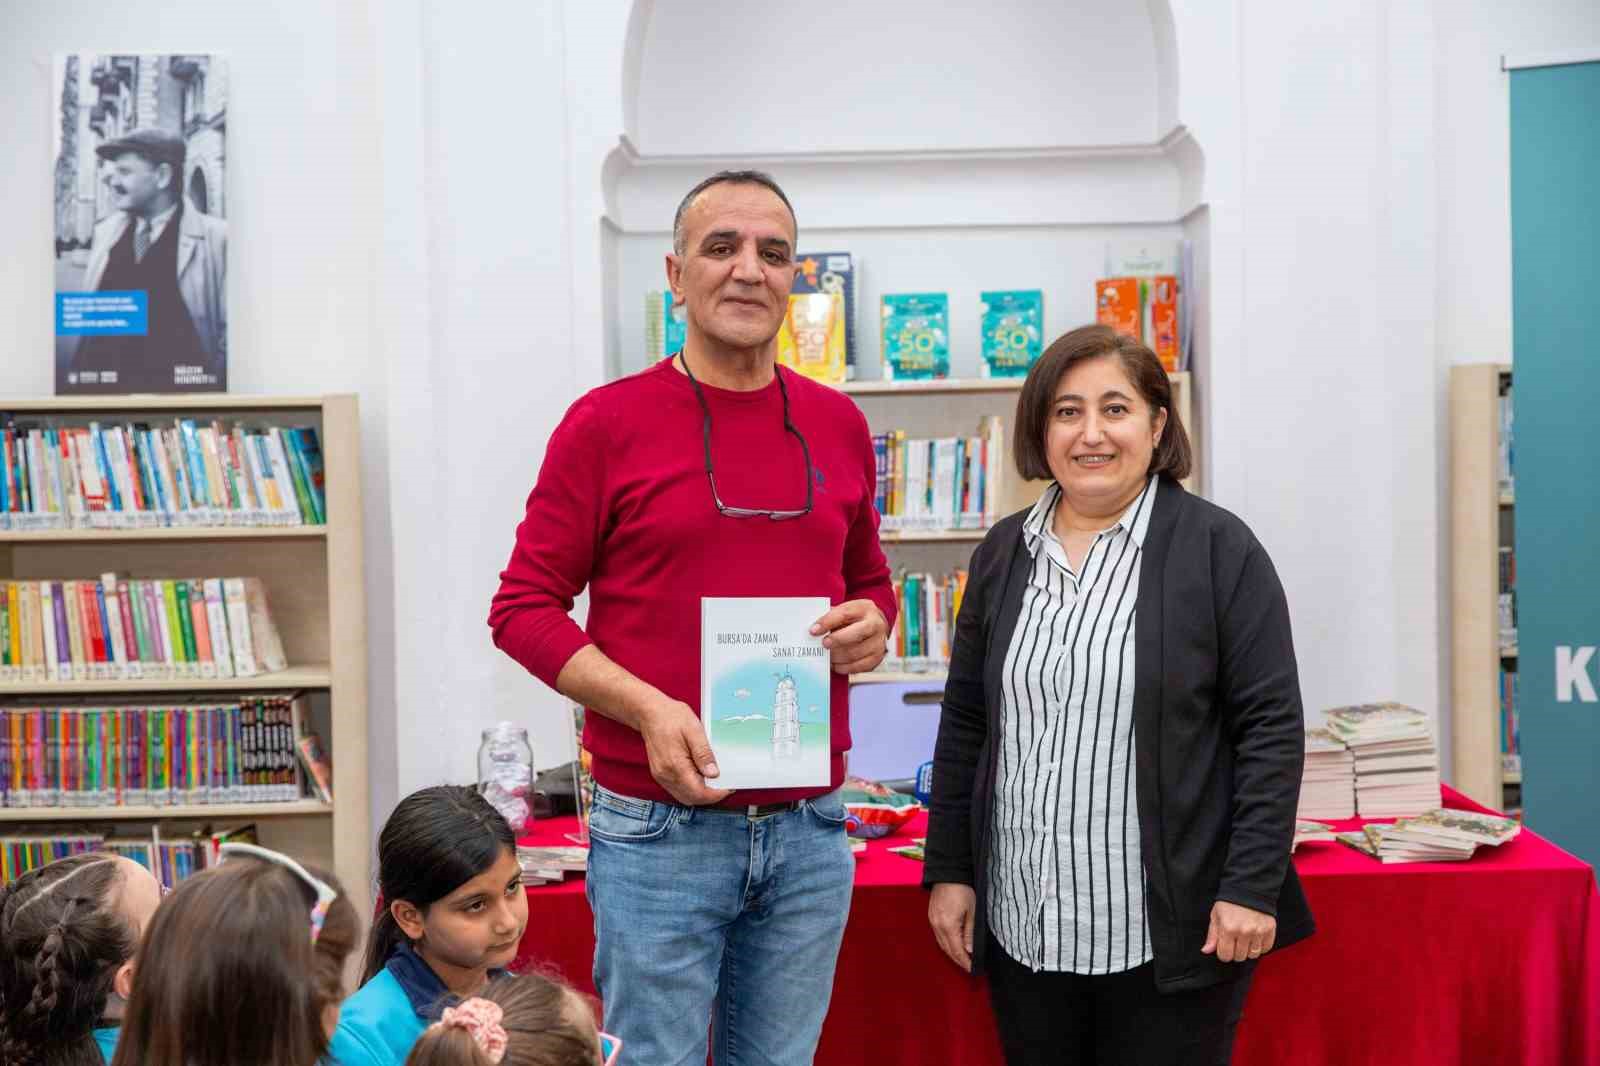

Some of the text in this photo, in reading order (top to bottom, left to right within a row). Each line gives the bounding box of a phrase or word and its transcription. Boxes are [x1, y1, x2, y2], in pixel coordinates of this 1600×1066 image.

[900, 329, 934, 352] 50
[995, 327, 1029, 350] 50
[717, 632, 778, 645] BURSA'DA ZAMAN
[772, 646, 824, 657] SANAT ZAMANI
